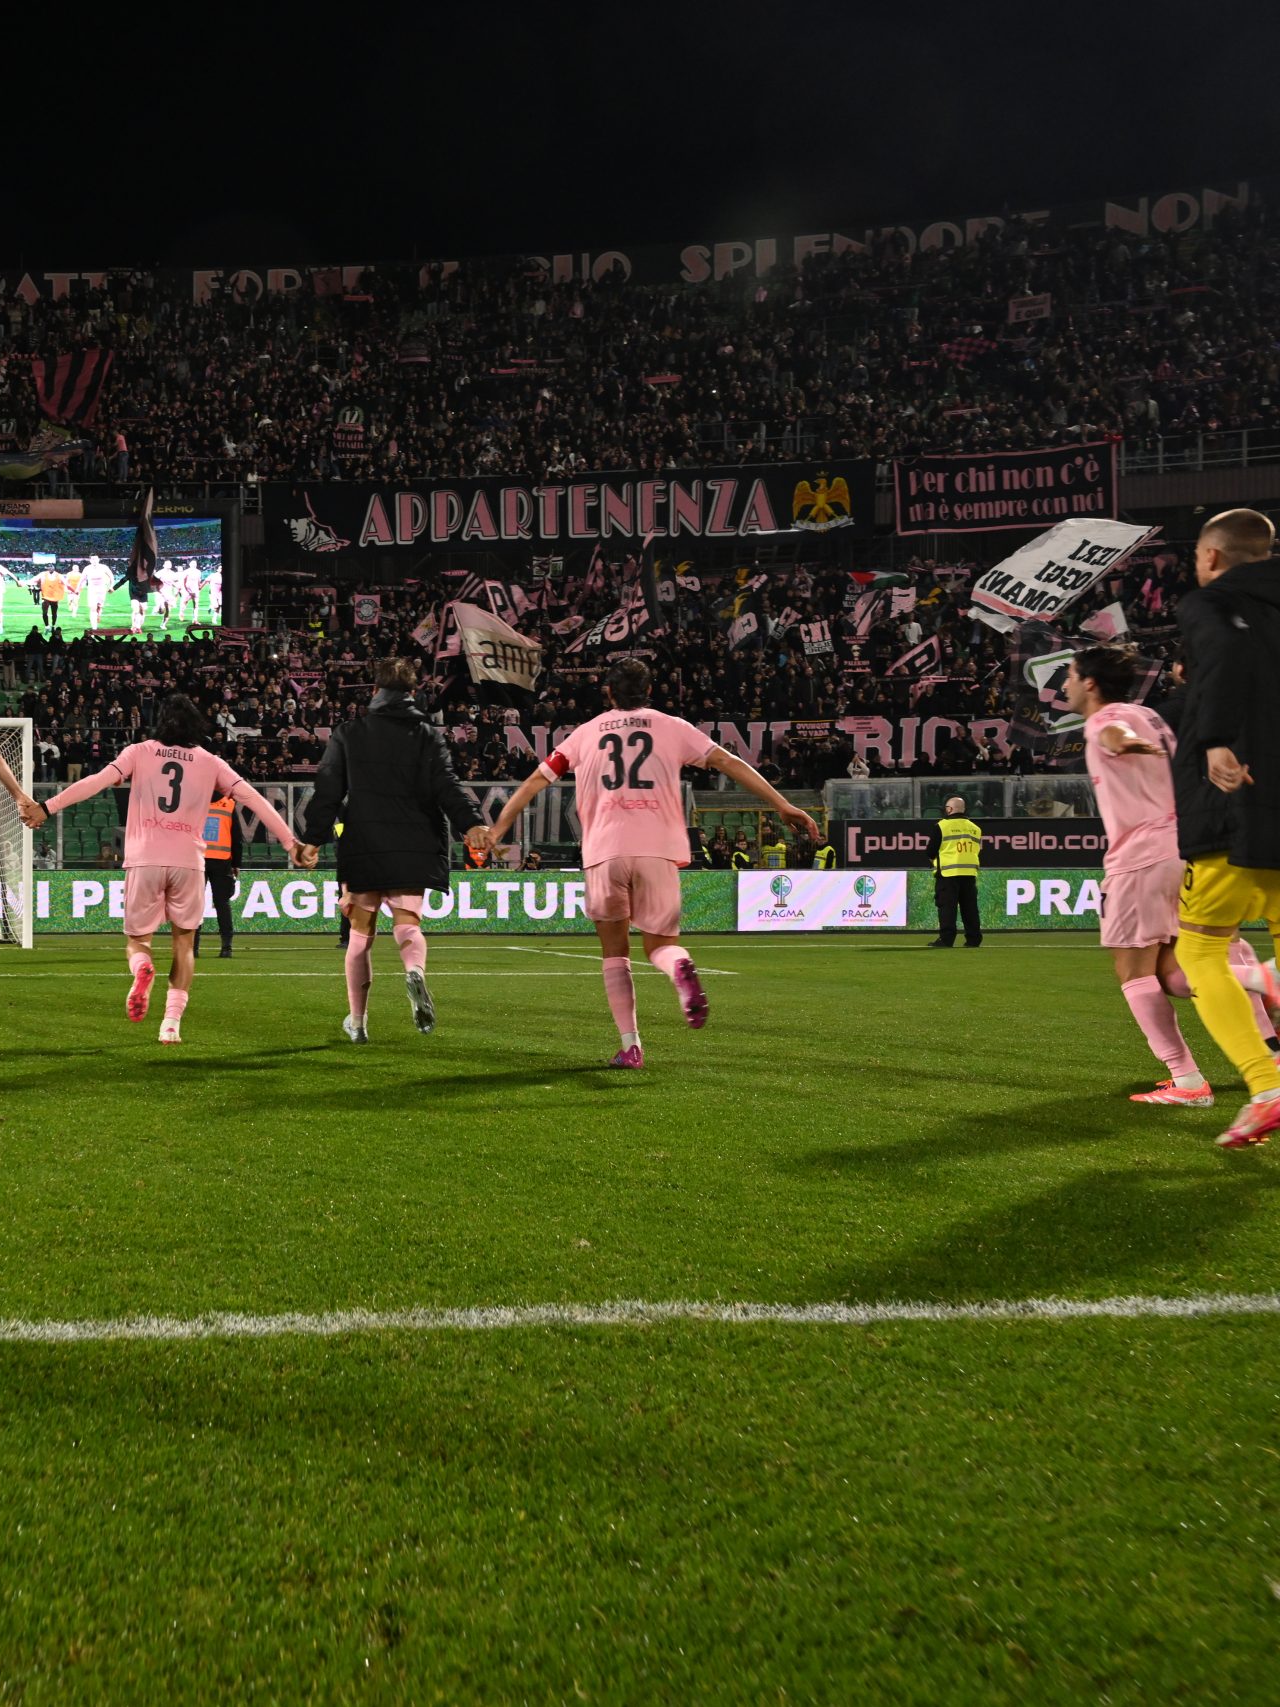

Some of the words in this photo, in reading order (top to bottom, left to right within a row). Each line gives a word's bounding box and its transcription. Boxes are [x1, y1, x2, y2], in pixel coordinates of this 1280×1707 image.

[954, 465, 995, 493] chi
[1003, 465, 1054, 490] non
[359, 478, 778, 547] APPARTENENZA
[908, 502, 935, 522] ma
[953, 499, 1028, 521] sempre
[1032, 497, 1068, 516] con
[1072, 486, 1105, 512] noi
[599, 717, 652, 732] CECCARONI
[155, 748, 194, 762] AUGELLO
[598, 731, 655, 791] 32
[157, 761, 184, 814] 3
[956, 841, 974, 854] 017
[72, 881, 125, 918] PE
[758, 909, 805, 918] PRAGMA
[842, 909, 889, 918] PRAGMA
